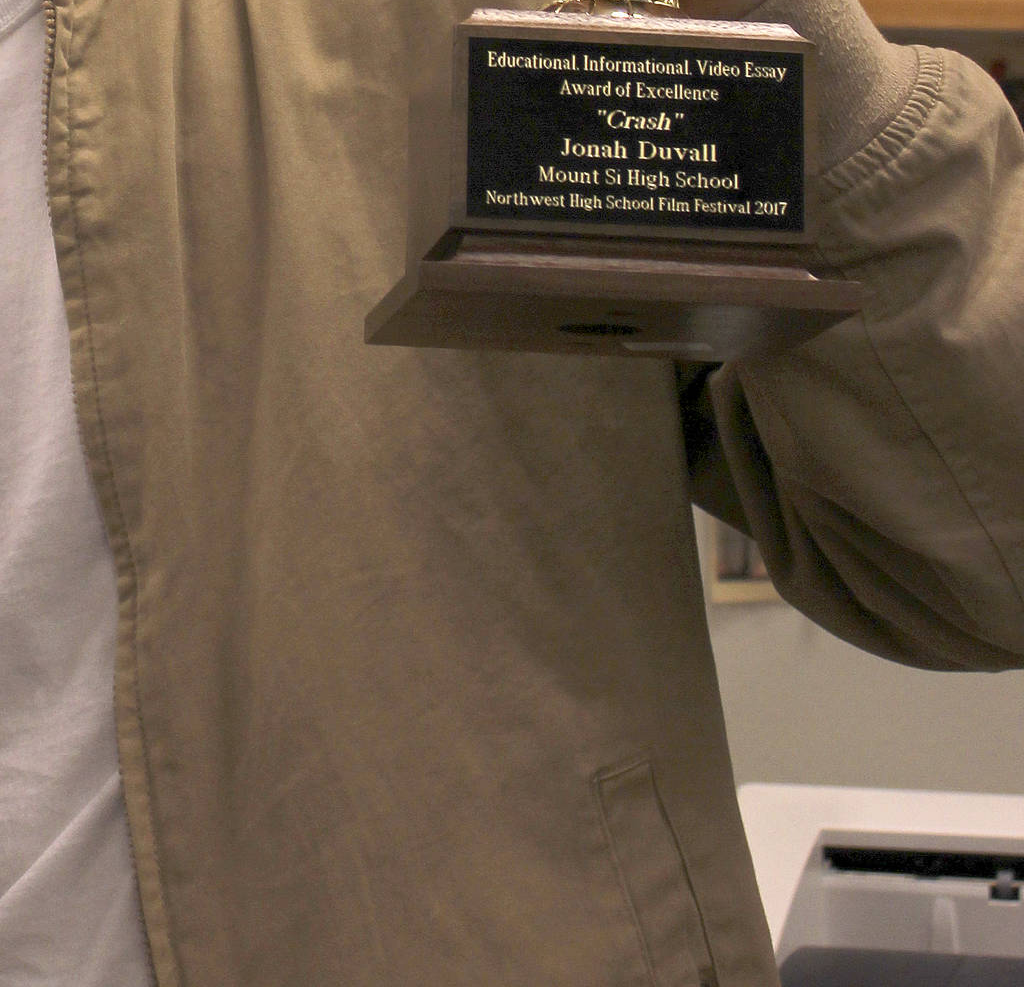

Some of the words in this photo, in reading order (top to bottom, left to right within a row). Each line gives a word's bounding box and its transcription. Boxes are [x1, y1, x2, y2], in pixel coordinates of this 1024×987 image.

[696, 59, 741, 79] Video
[744, 61, 788, 83] Essay
[560, 79, 612, 98] Award
[615, 81, 632, 98] of
[636, 82, 720, 102] Excellence
[597, 109, 685, 131] "Crash"
[560, 137, 628, 160] Jonah
[638, 140, 718, 163] Duvall
[538, 165, 601, 185] Mount
[604, 168, 622, 186] Si
[627, 168, 671, 191] High
[675, 171, 741, 191] School
[486, 189, 566, 208] Northwest
[569, 193, 603, 212] High
[605, 195, 655, 211] School
[658, 197, 690, 213] Film
[694, 198, 751, 215] Festival
[754, 201, 789, 217] 2017
